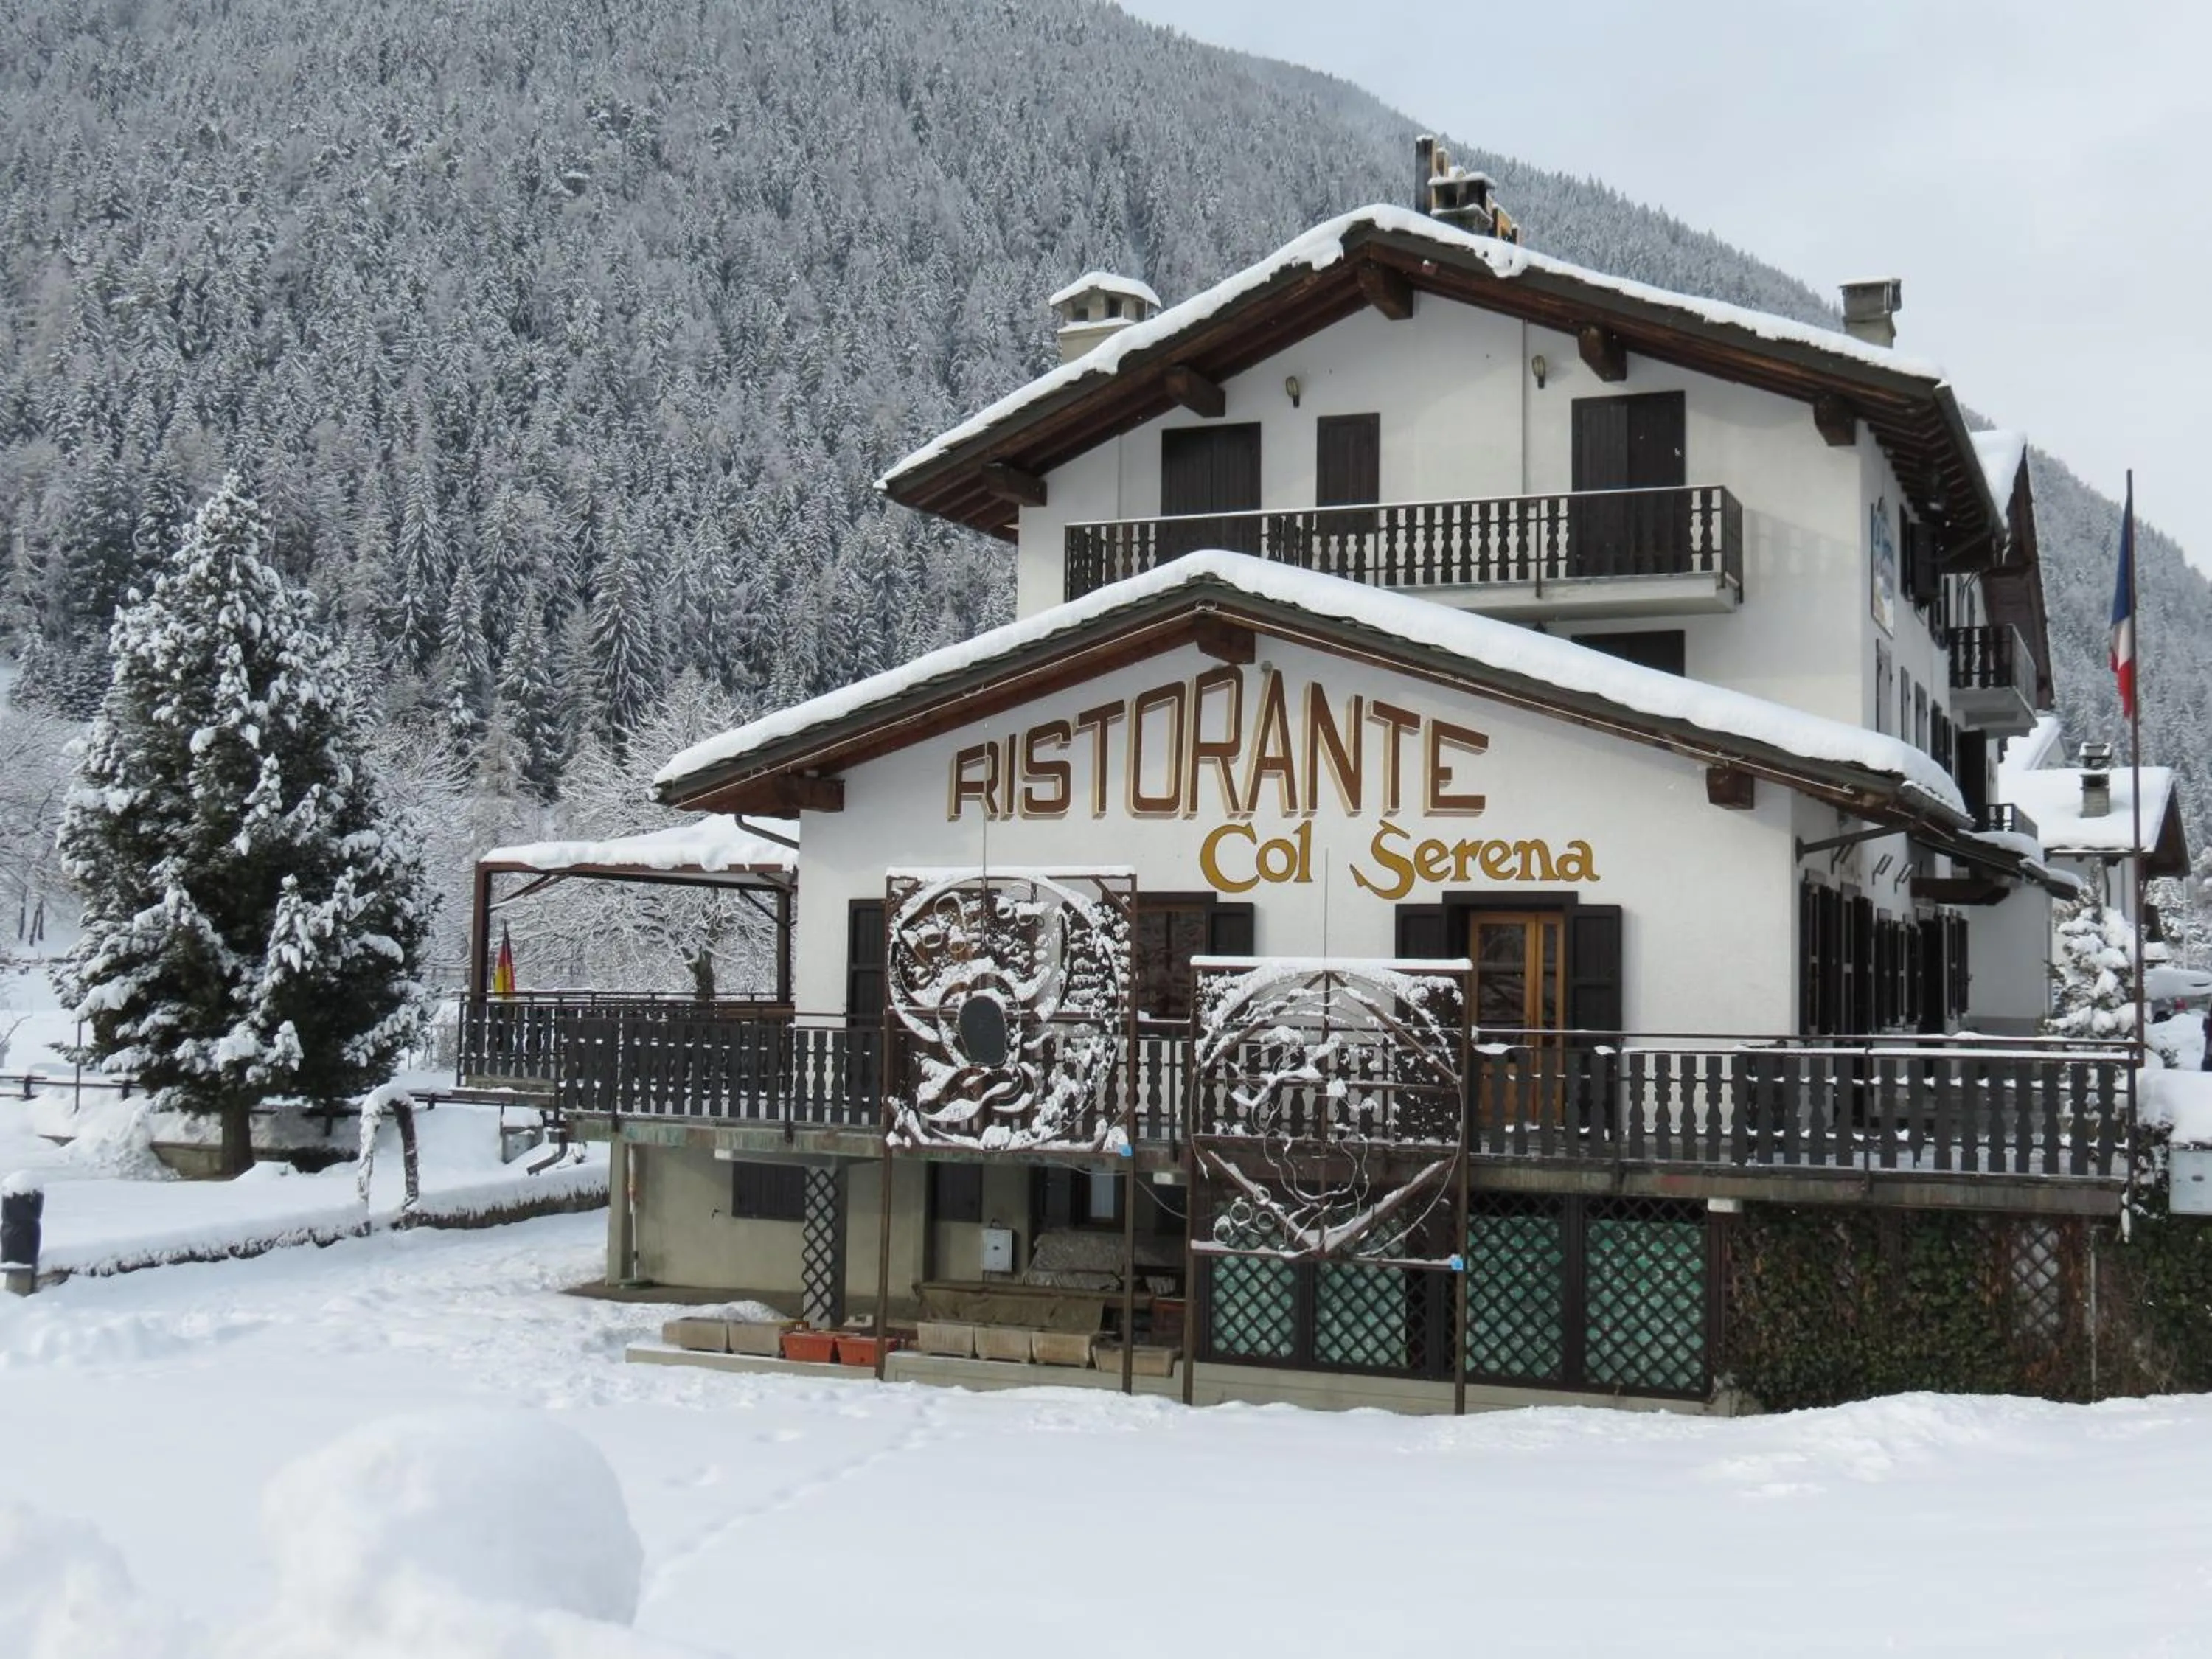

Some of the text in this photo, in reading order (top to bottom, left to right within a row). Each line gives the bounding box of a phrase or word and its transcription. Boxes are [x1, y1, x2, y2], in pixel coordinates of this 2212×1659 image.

[947, 665, 1490, 822] RISTORANTE
[1200, 819, 1601, 901] Col Serena
